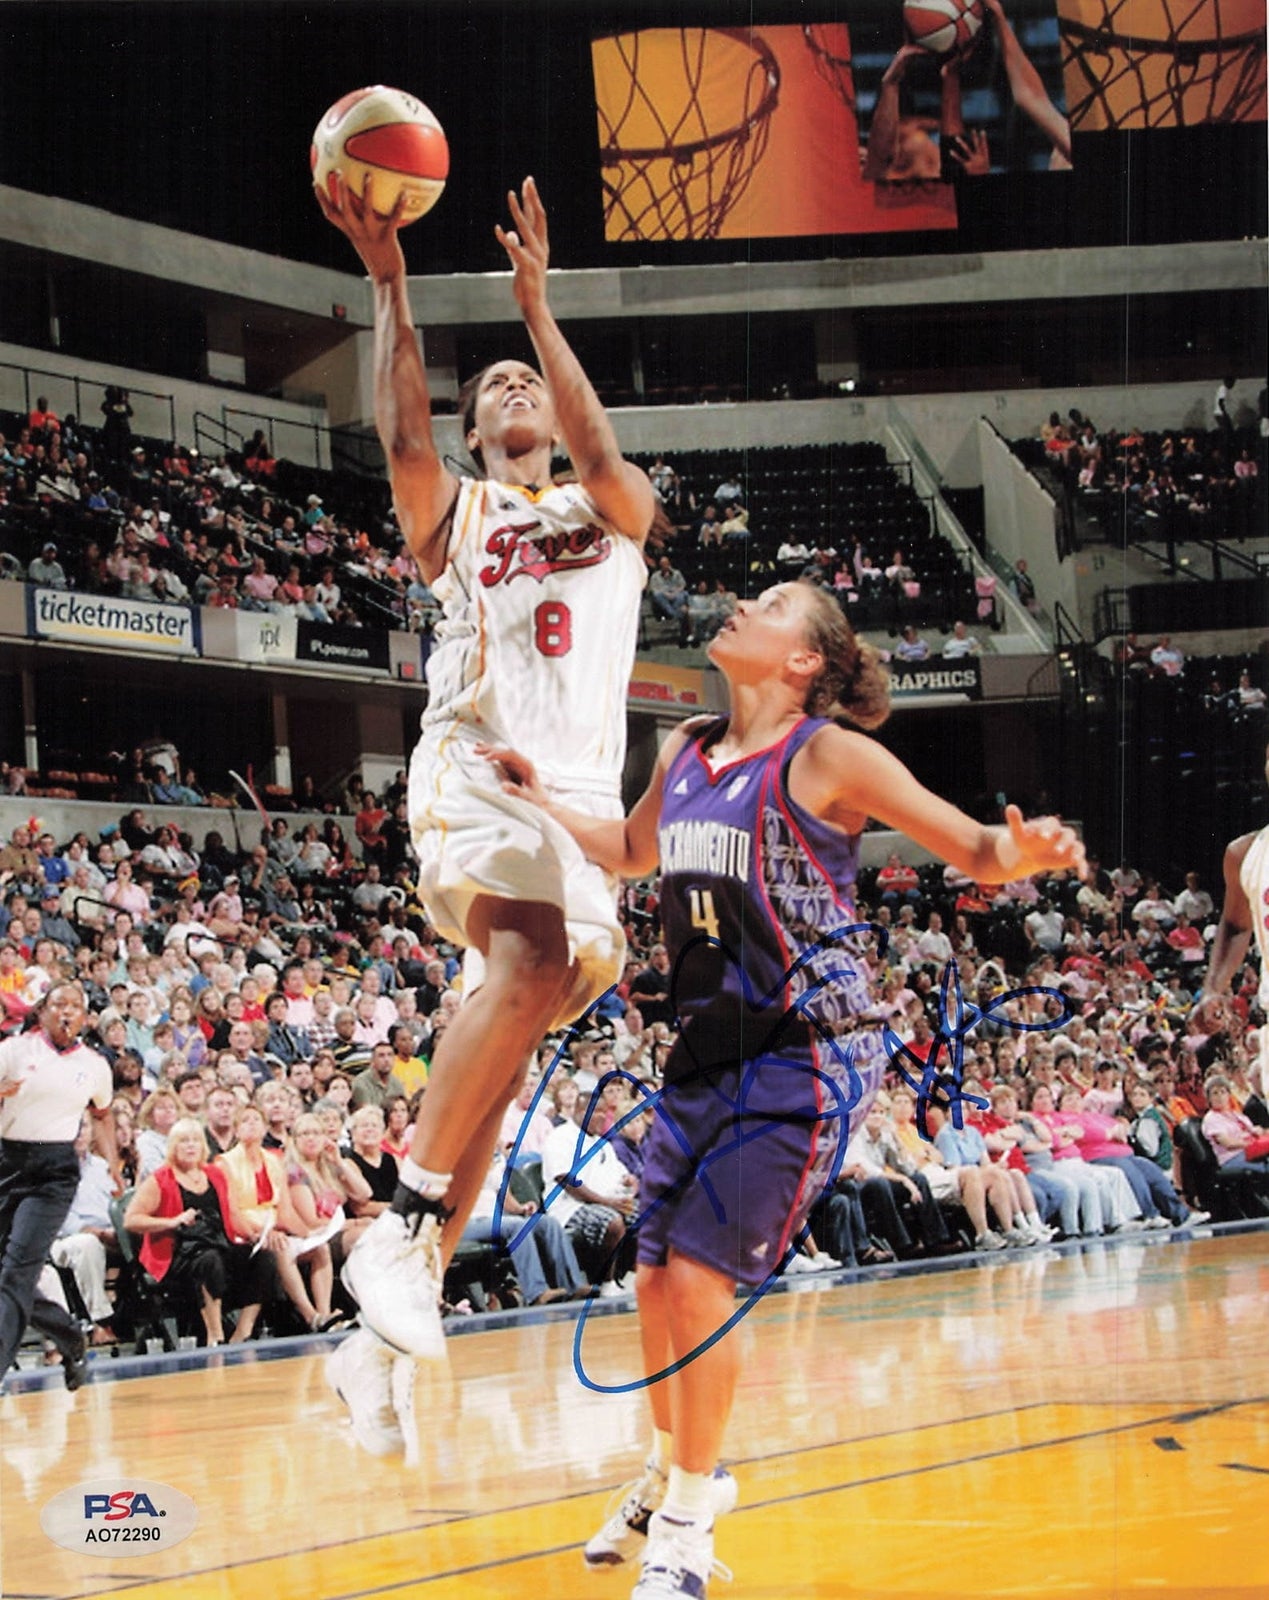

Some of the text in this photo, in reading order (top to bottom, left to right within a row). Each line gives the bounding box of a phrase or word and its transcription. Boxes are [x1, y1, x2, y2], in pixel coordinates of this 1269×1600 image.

[479, 520, 611, 588] Fever
[40, 592, 190, 638] ticketmaster
[534, 600, 573, 657] 8
[690, 890, 721, 947] 4
